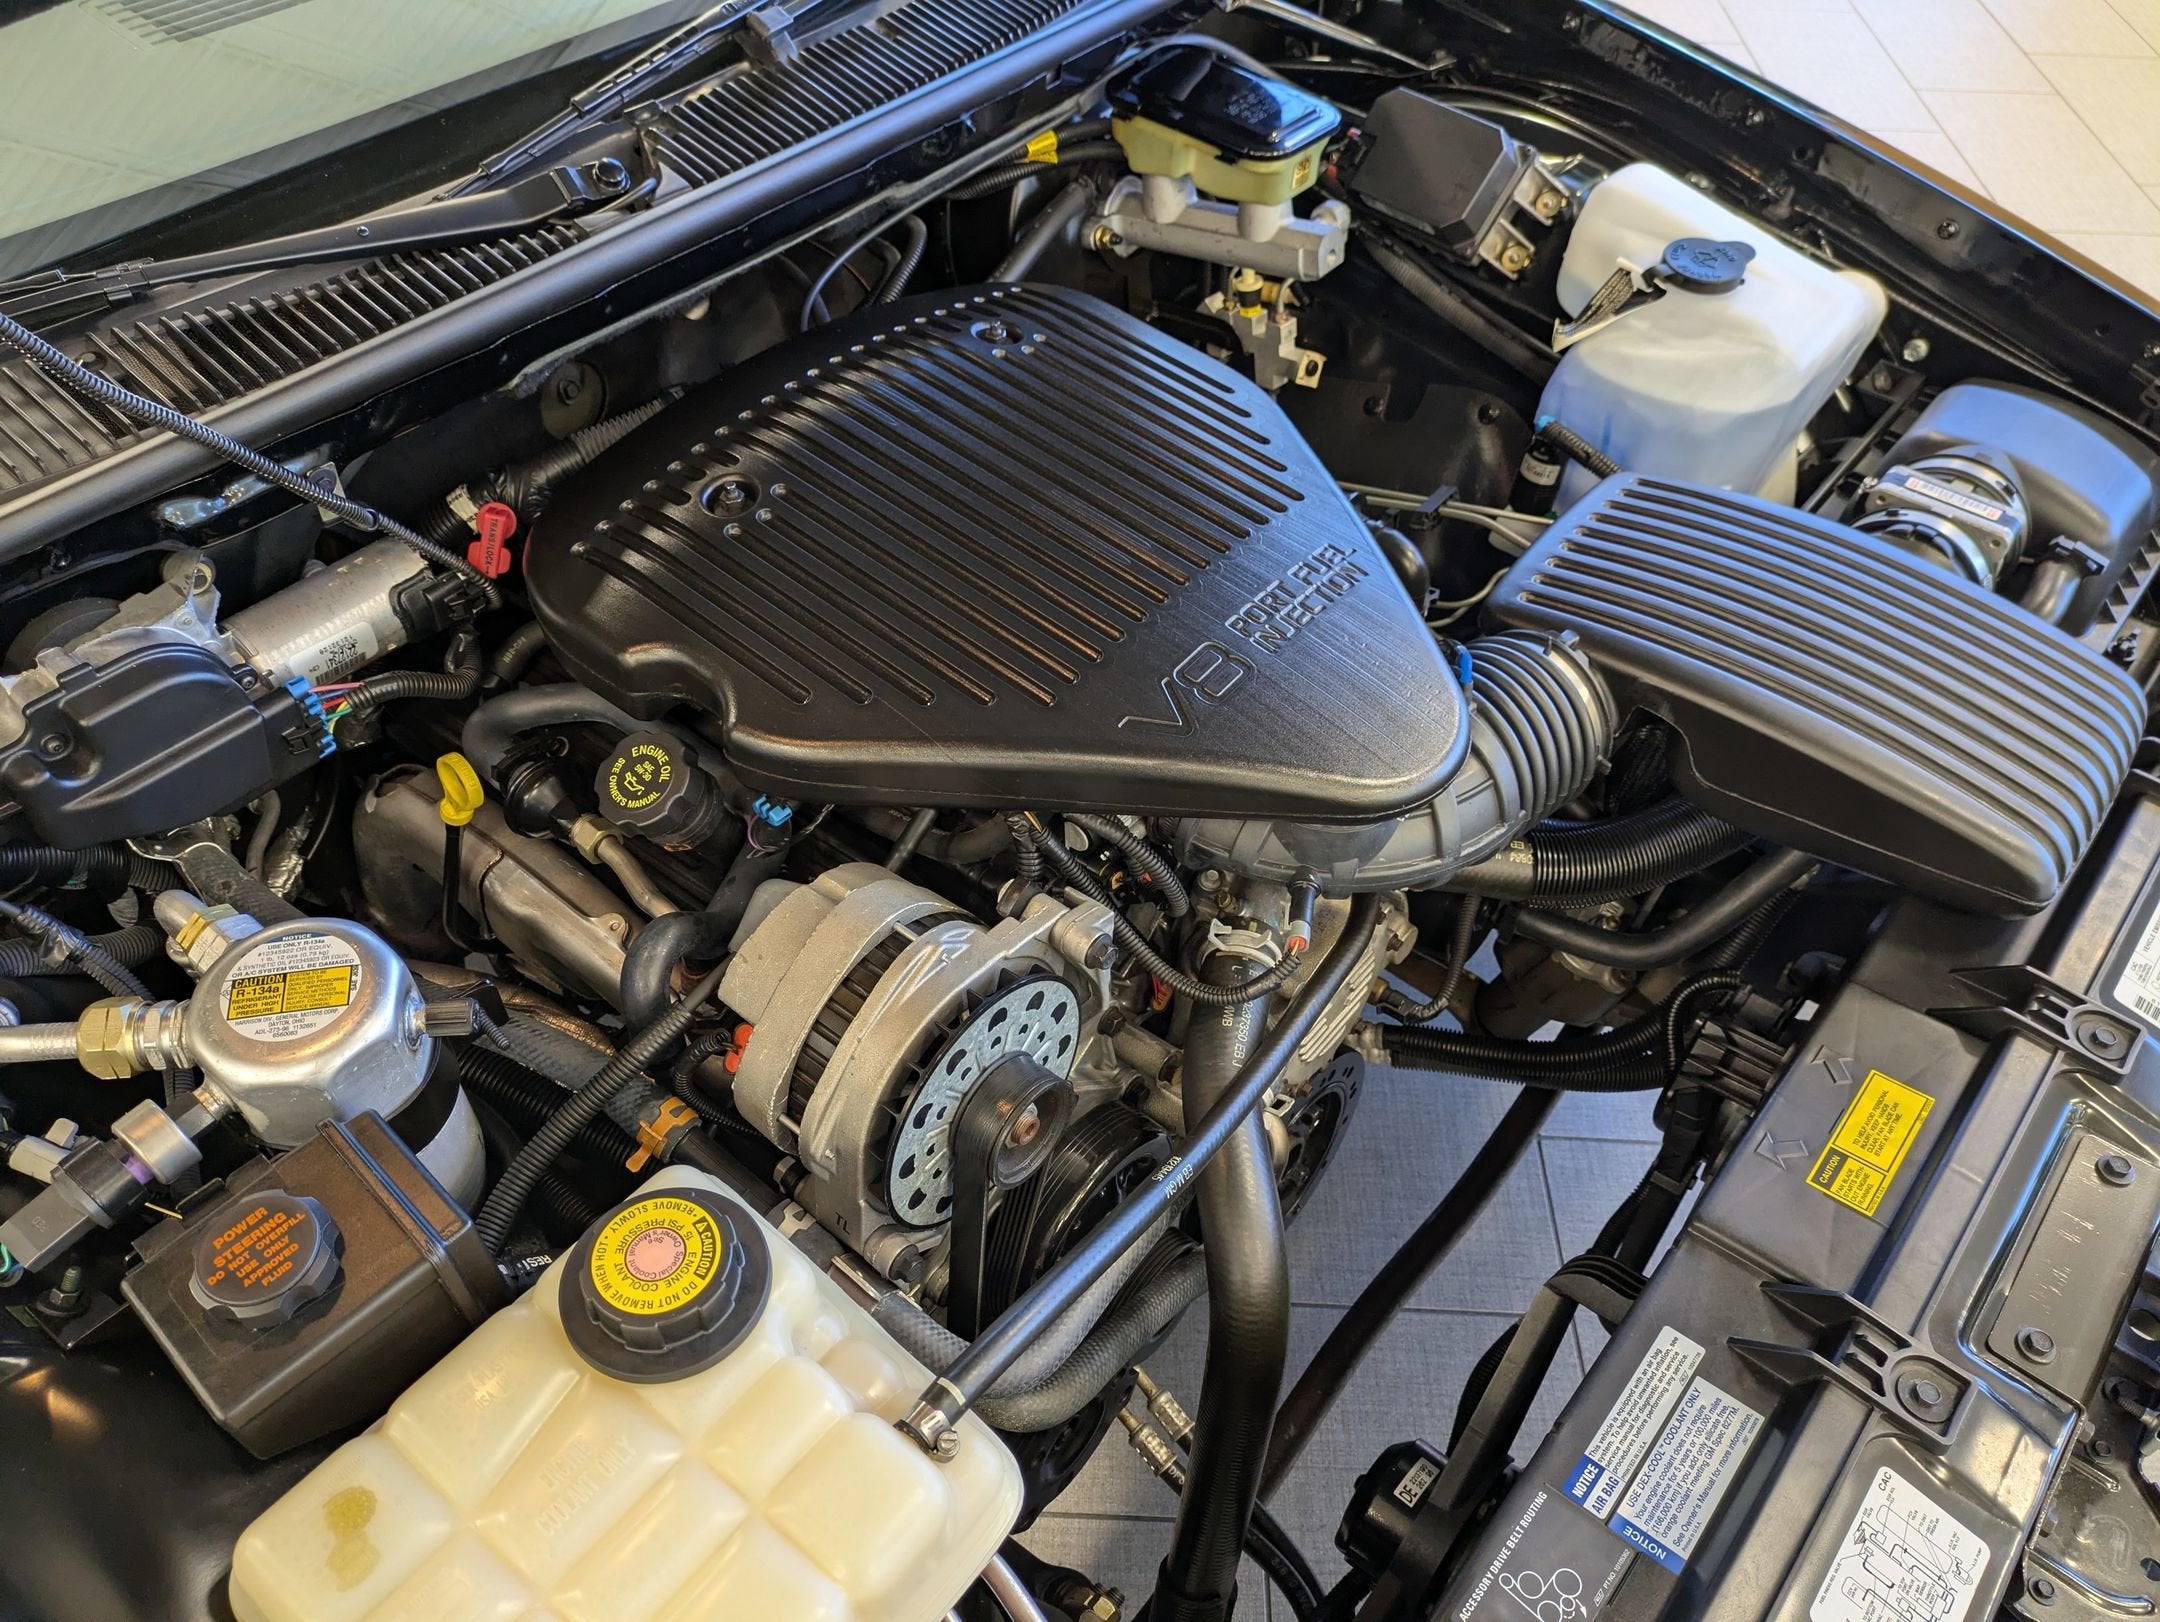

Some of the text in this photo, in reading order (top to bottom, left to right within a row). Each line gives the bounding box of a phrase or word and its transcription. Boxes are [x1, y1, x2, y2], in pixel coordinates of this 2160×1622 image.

[1225, 544, 1355, 637] PORT FUEL
[1249, 561, 1368, 652] INJECTION
[1119, 643, 1254, 738] V8
[631, 745, 670, 782] ENGINE OIL
[642, 760, 654, 773] SAE
[609, 757, 660, 808] SEE OWNER'S MANUAL
[282, 932, 312, 941] NOTICE
[234, 974, 284, 988] CAUTION
[257, 966, 287, 974] SYSTEM
[318, 958, 354, 967] DAMAGED
[231, 994, 281, 1004] REFRIGERANT
[235, 985, 280, 998] R-134a
[235, 1007, 274, 1016] PRESSURE
[1870, 1119, 1880, 1131] KEEP
[1877, 1103, 1889, 1119] HANDS
[1872, 1089, 1888, 1113] PERSONAL
[1874, 1142, 1885, 1156] START
[1886, 1124, 1895, 1134] ANY
[1876, 1126, 1885, 1136] FAN
[1882, 1111, 1893, 1127] BLADE
[1818, 1154, 1840, 1184] CAUTION
[1836, 1168, 1854, 1194] FAN BLADE
[1843, 1179, 1857, 1198] STARTS
[1850, 1172, 1870, 1202] OUT ENGINE
[212, 1205, 268, 1250] POWER
[610, 1201, 695, 1233] REMOVE SLOWLY
[667, 1219, 685, 1231] PSI
[207, 1210, 305, 1286] DO NOT OVERFILL
[213, 1209, 287, 1268] STEERING
[614, 1218, 665, 1254] PRESSURE
[629, 1231, 651, 1256] Manual
[236, 1235, 291, 1278] USE ONLY
[242, 1241, 299, 1287] APPROVED
[261, 1260, 293, 1286] FLUID
[595, 1231, 711, 1309] CAUTION DO NOT REMOVE WHEN HOT
[614, 1251, 696, 1291] ENGINE COOLANT
[628, 1251, 683, 1279] Special Coolant
[1589, 1443, 1601, 1458] This
[1597, 1422, 1614, 1444] vehicle
[1615, 1388, 1637, 1417] equipped
[1632, 1375, 1644, 1389] with
[1645, 1359, 1654, 1368] air
[1650, 1347, 1663, 1360] bag
[1596, 1439, 1616, 1464] system.
[1611, 1429, 1620, 1439] To
[1616, 1416, 1630, 1431] help
[1625, 1399, 1639, 1416] avoid
[1635, 1370, 1657, 1400] unwanted
[1669, 1336, 1679, 1347] see
[1603, 1350, 1680, 1468] service manual for diagnostic and service
[1610, 1437, 1637, 1474] procedures
[1632, 1418, 1648, 1438] before
[1644, 1385, 1669, 1419] performing
[1665, 1376, 1676, 1387] any
[1671, 1352, 1688, 1376] service.
[1707, 1396, 1722, 1415] miles
[1689, 1439, 1697, 1448] or
[1692, 1414, 1712, 1440] 100,000
[1625, 1489, 1642, 1508] USE
[1660, 1407, 1692, 1446] COOLANT
[1683, 1387, 1703, 1409] ONLY
[1633, 1403, 1707, 1521] Your engine coolant does not require
[1677, 1447, 1694, 1468] years
[1571, 1463, 1600, 1498] NOTICE
[1650, 1502, 1673, 1532] (166,000
[1667, 1488, 1681, 1503] km)
[1679, 1469, 1693, 1484] you
[1686, 1455, 1699, 1470] add
[1694, 1440, 1708, 1456] only
[1702, 1417, 1721, 1441] silicate
[1659, 1513, 1679, 1538] orange
[1673, 1486, 1693, 1513] coolant
[1687, 1459, 1710, 1488] meeting
[1703, 1446, 1716, 1460] GM
[1710, 1429, 1727, 1448] Spec
[1667, 1471, 1678, 1483] for
[1672, 1531, 1686, 1547] See
[1680, 1502, 1702, 1532] Owner's
[1696, 1477, 1716, 1503] Manual
[1711, 1467, 1722, 1478] for
[1717, 1449, 1731, 1467] more
[1727, 1411, 1754, 1450] information.
[1877, 1471, 1892, 1491] CAC
[1399, 1484, 1417, 1503] DE
[1590, 1475, 1620, 1513] AIR BAG
[1642, 1482, 1672, 1526] maintenance
[1458, 1491, 1547, 1621] ACCESSORY DRIVE BELT ROUTING
[1622, 1524, 1667, 1559] NOTICE
